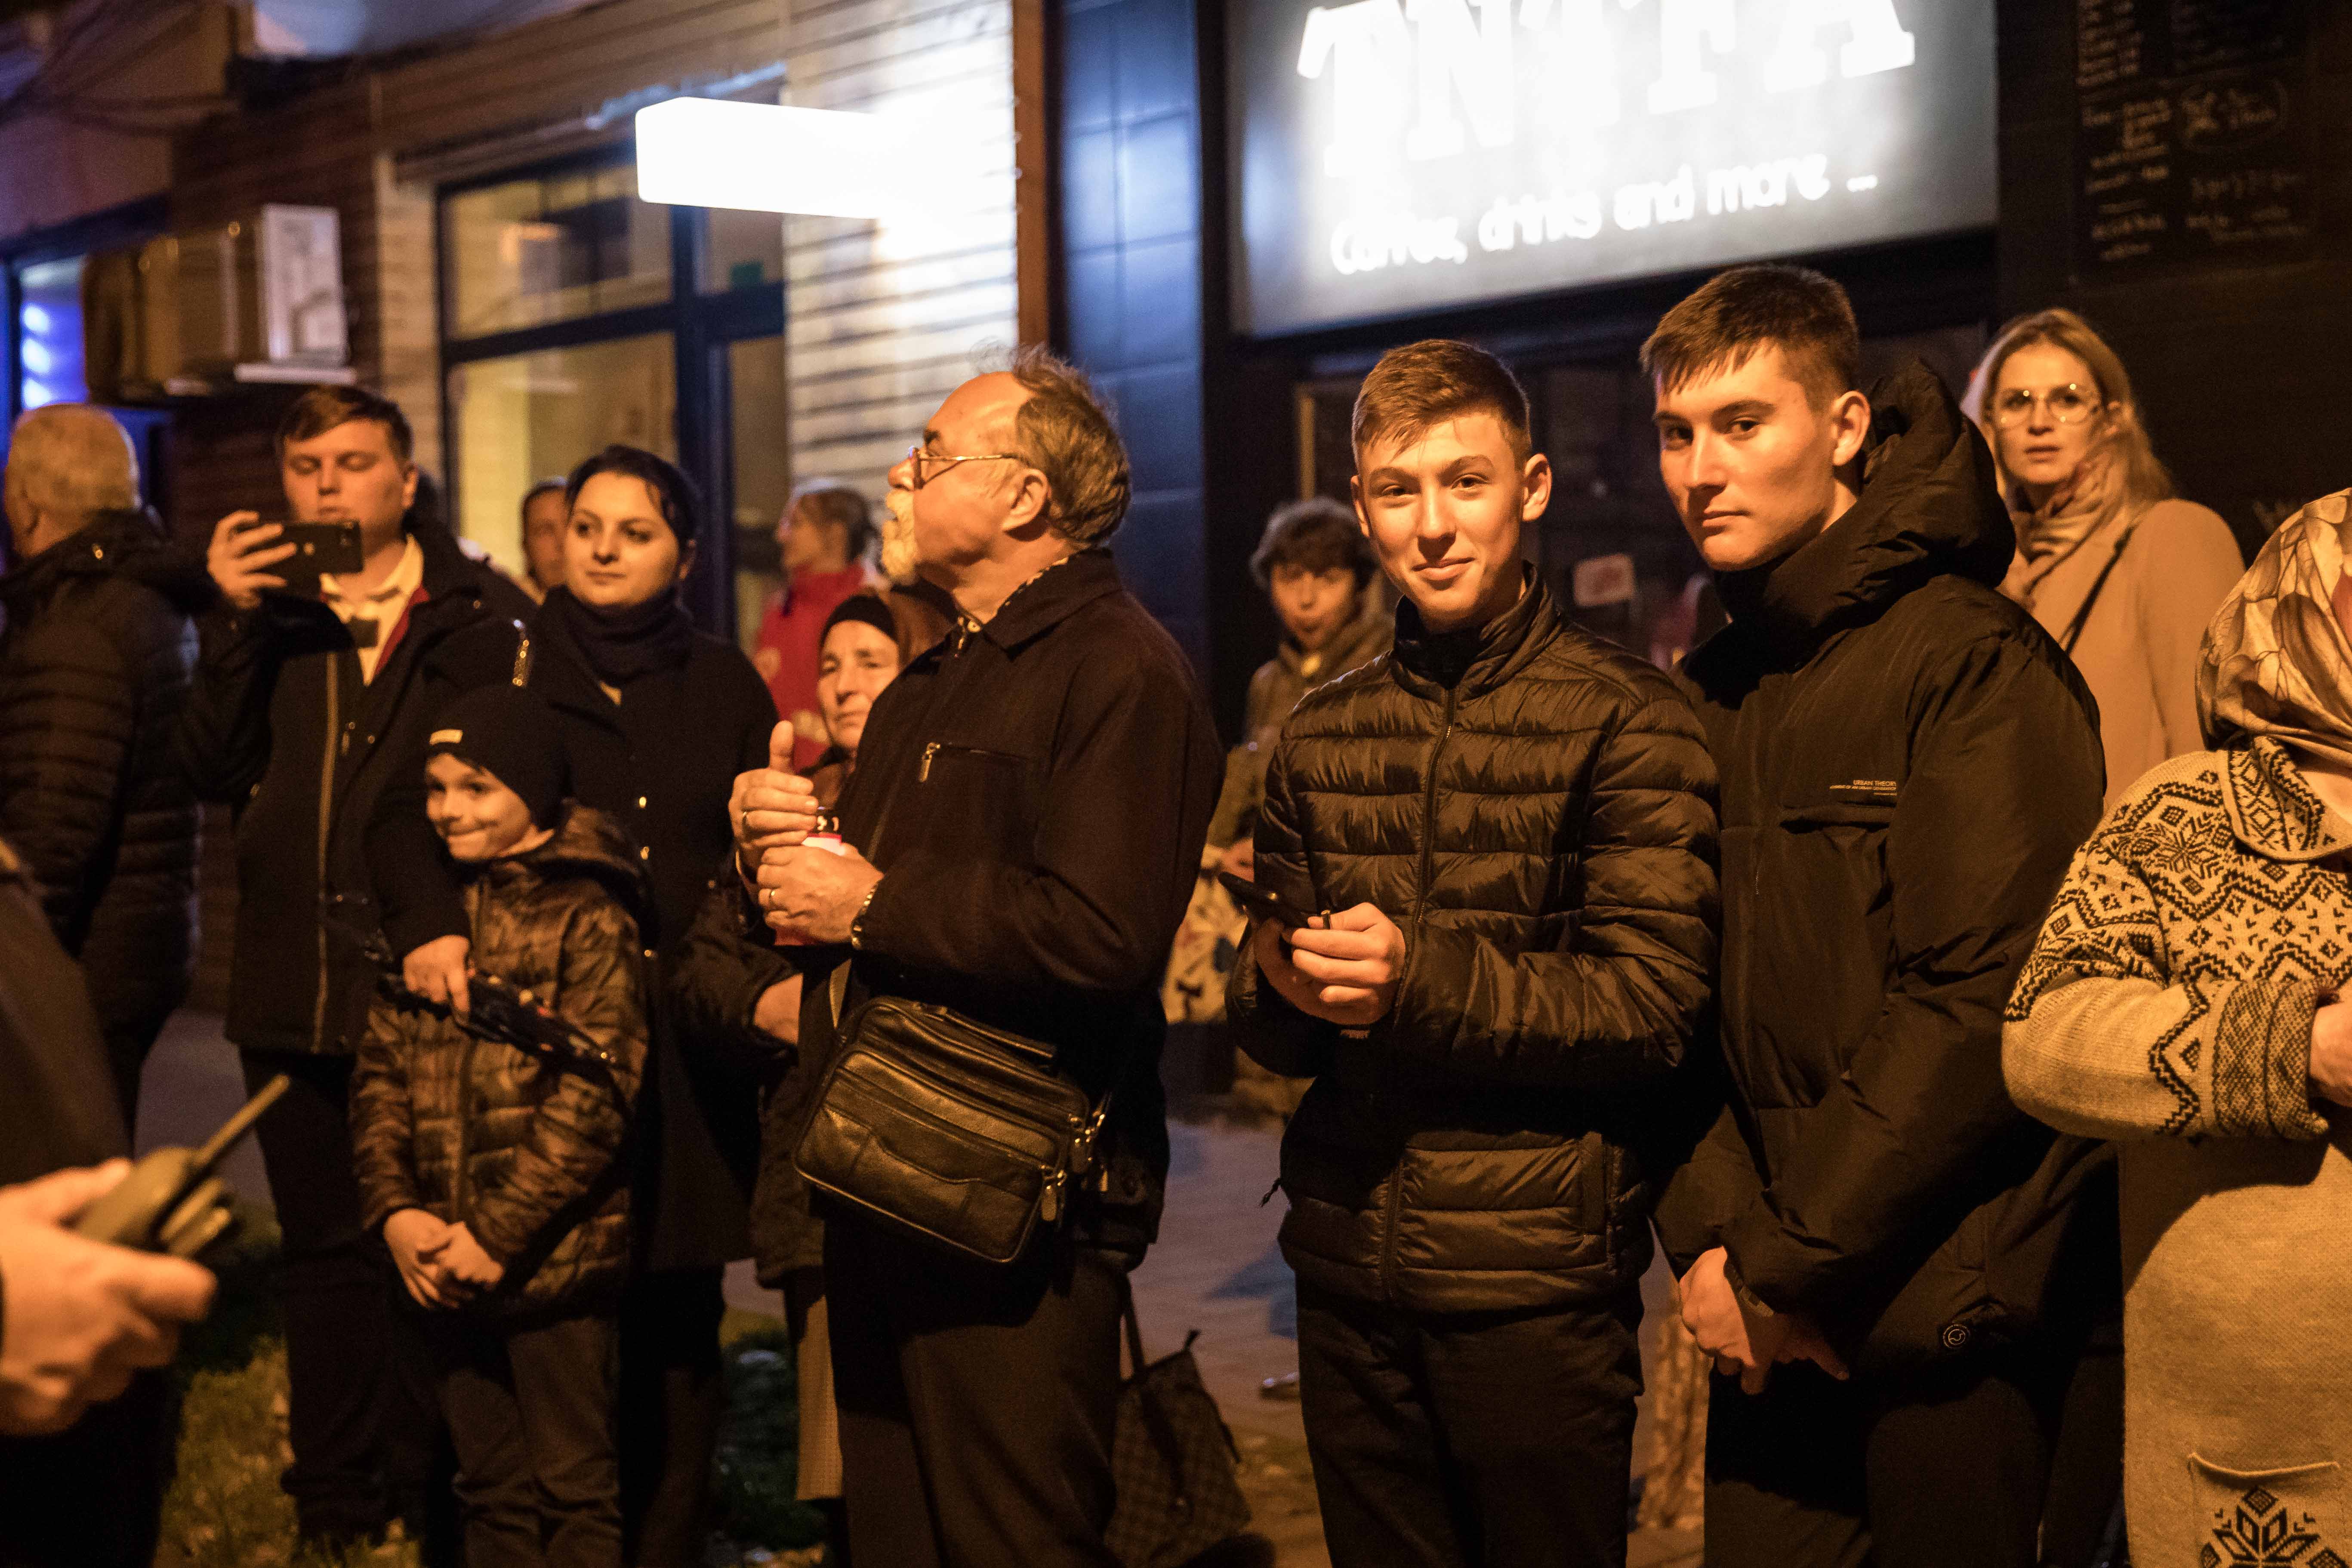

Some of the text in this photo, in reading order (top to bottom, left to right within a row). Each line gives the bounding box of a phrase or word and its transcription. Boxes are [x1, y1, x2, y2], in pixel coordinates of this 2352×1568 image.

[1477, 187, 1603, 252] drinks
[1613, 163, 1695, 231] and
[1707, 153, 1831, 216] more
